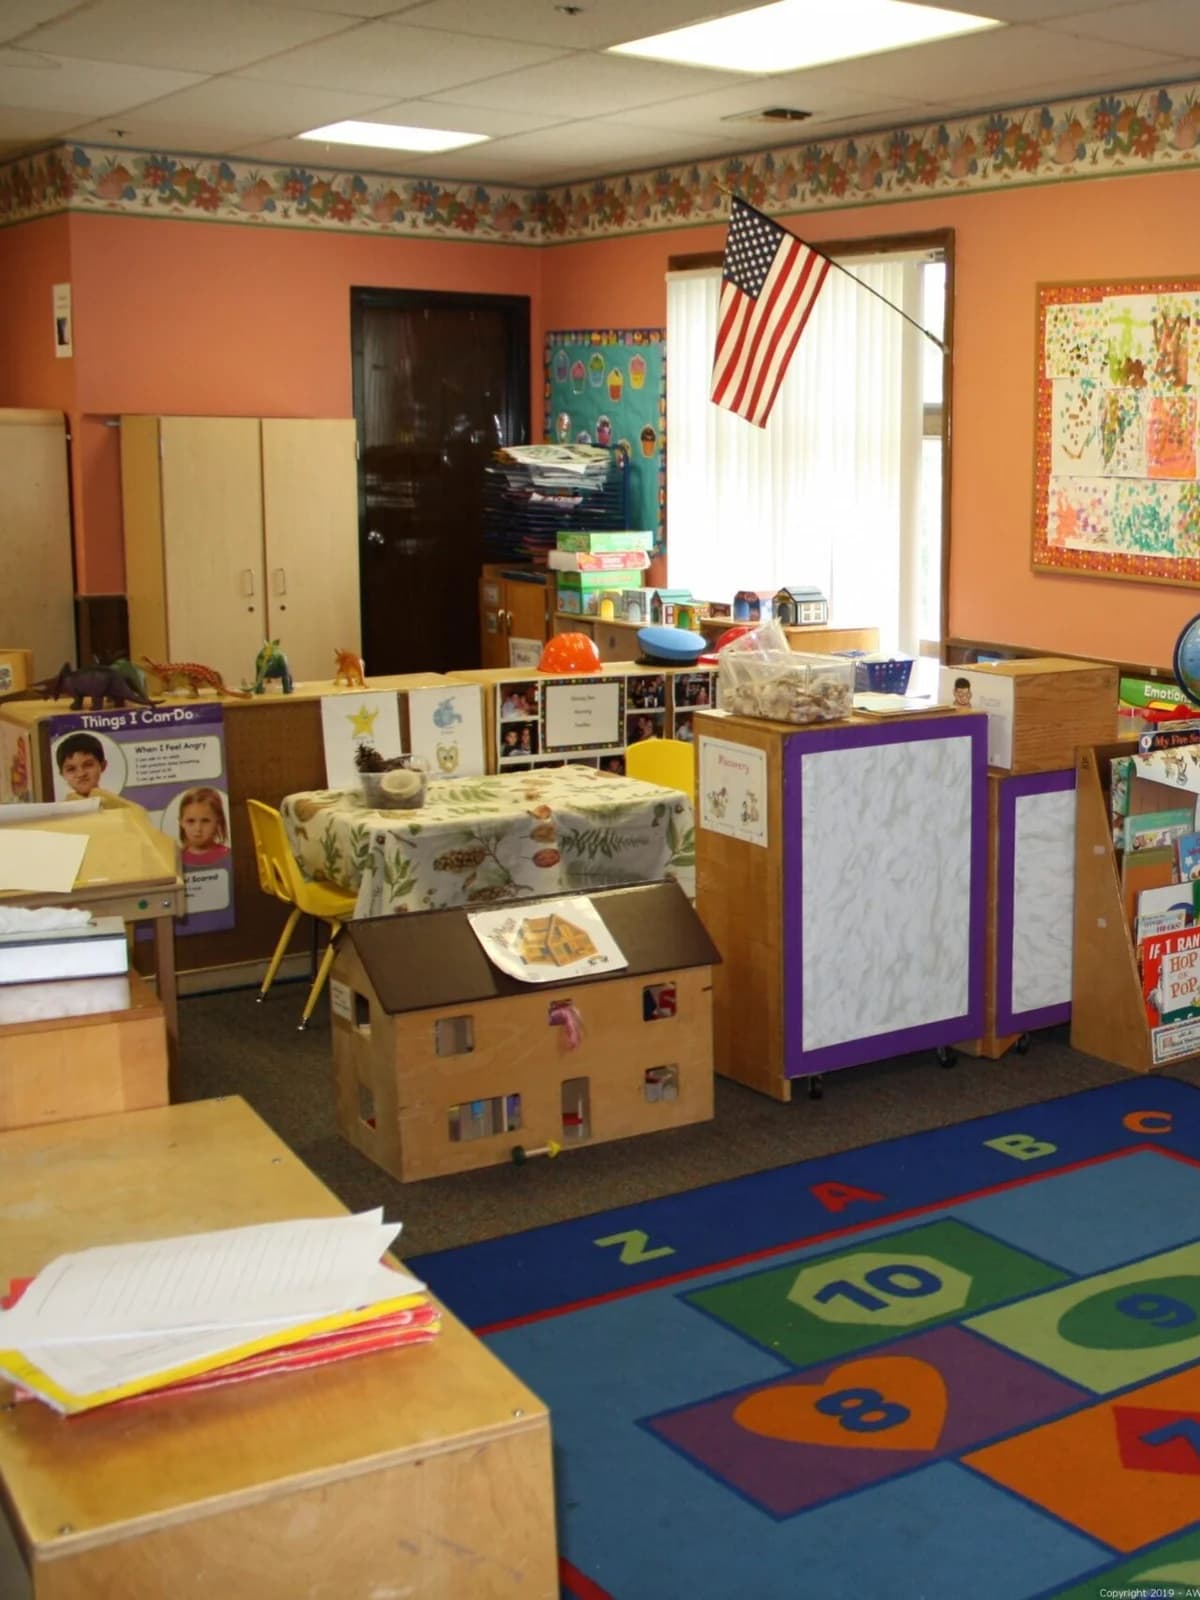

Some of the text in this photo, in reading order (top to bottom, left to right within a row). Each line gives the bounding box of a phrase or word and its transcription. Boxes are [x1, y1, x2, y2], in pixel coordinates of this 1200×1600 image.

[1143, 684, 1192, 704] Emotion
[80, 708, 194, 731] Things I Can Do
[1156, 735, 1169, 748] My
[1149, 942, 1161, 961] IF
[1177, 932, 1200, 953] RAN
[1169, 951, 1199, 974] HOP
[1169, 976, 1199, 999] POP
[1122, 1110, 1173, 1134] C
[983, 1133, 1058, 1161] B
[809, 1180, 888, 1213] A
[813, 1264, 943, 1312] 10
[1114, 1293, 1198, 1329] 9
[813, 1387, 911, 1433] 8
